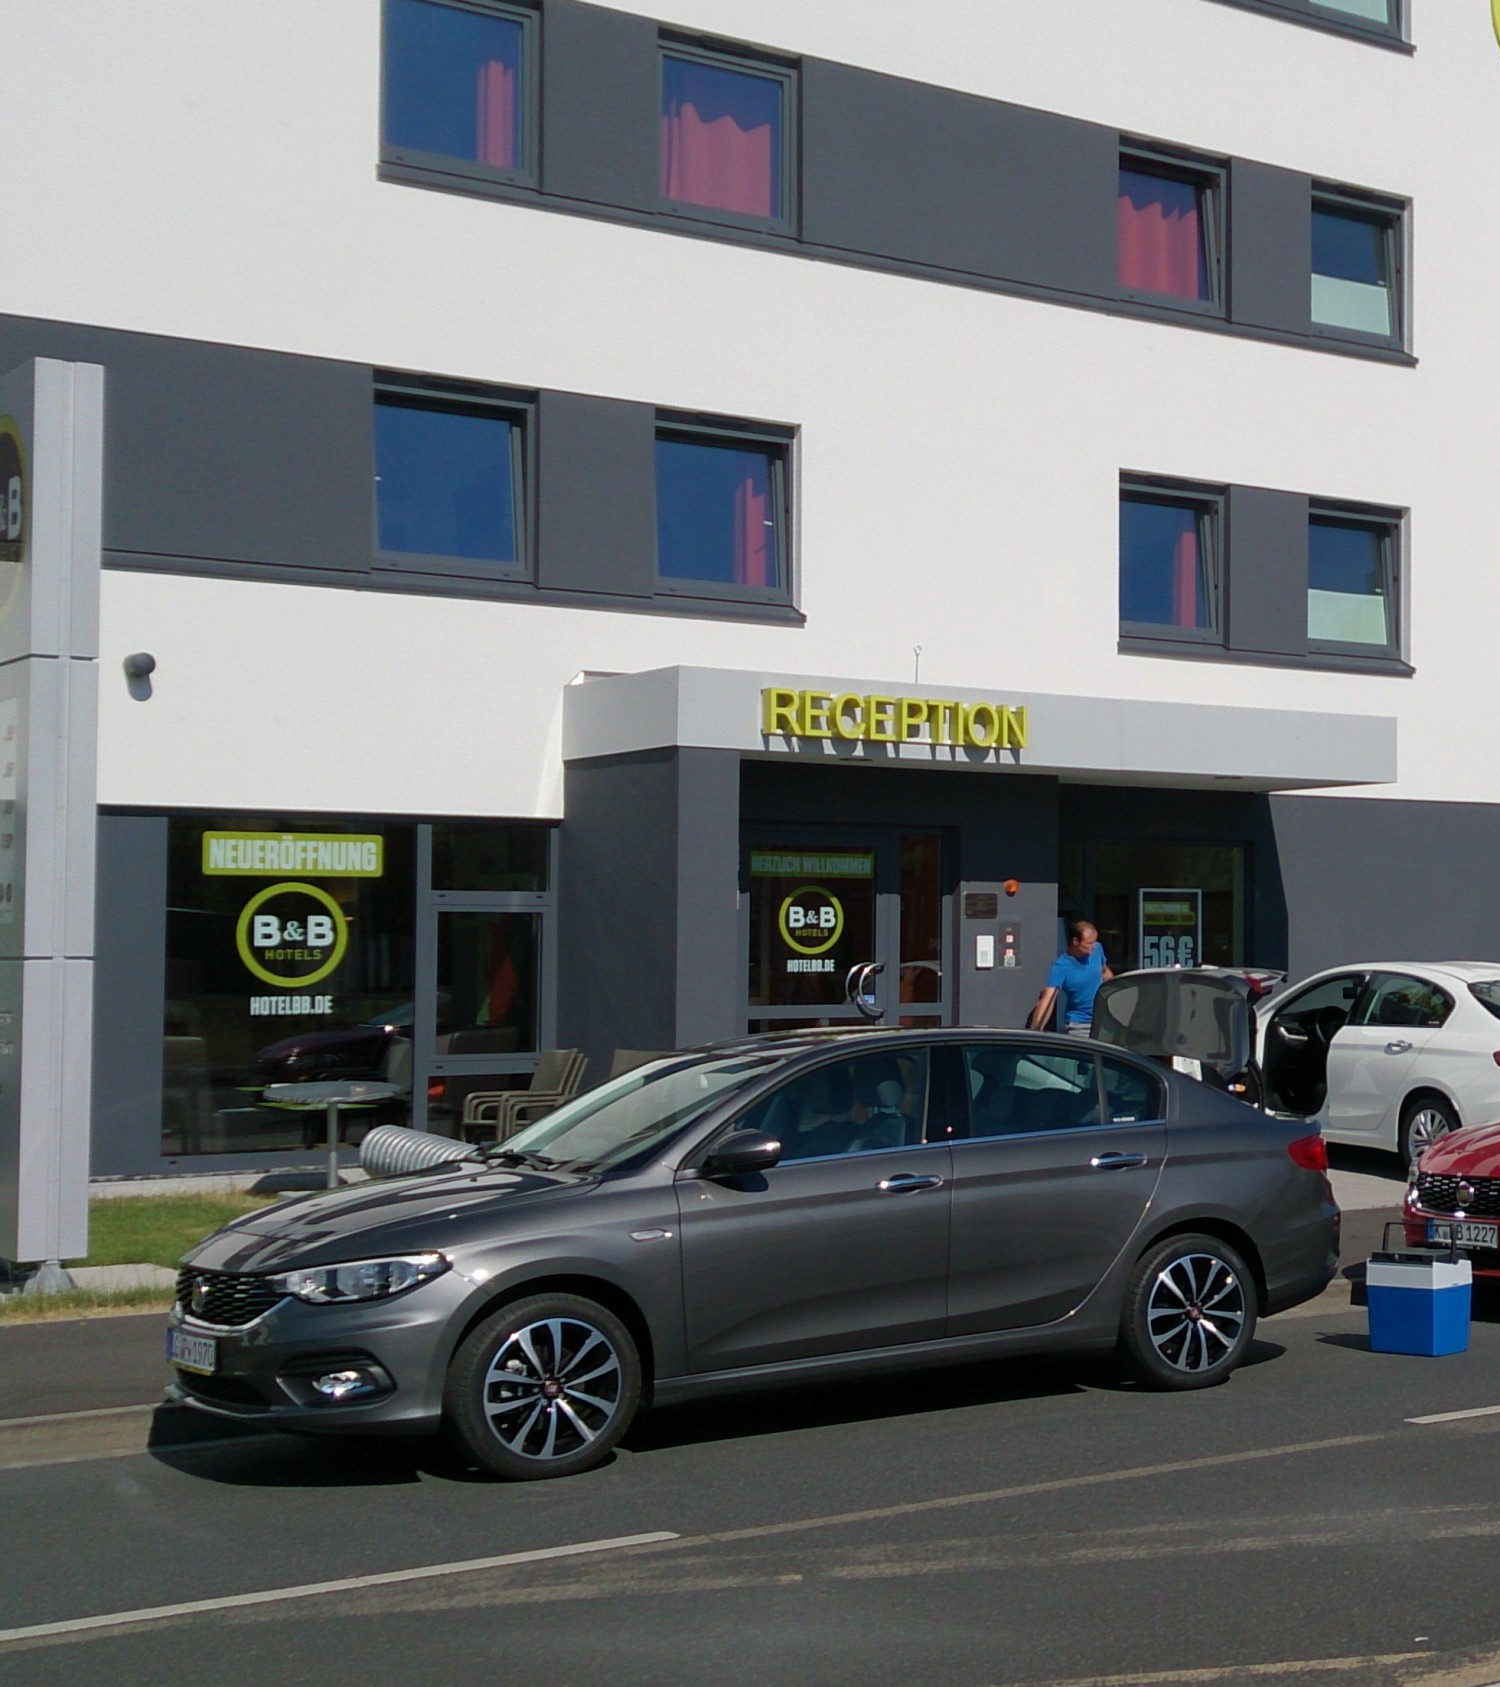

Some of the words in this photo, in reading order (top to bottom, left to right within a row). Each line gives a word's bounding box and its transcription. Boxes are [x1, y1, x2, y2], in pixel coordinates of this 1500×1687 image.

[760, 687, 1029, 749] RECEPTION
[209, 835, 377, 871] NEUERÖFFNUNG
[253, 914, 334, 947] B&B
[788, 906, 836, 928] B&B
[265, 949, 321, 960] HOTELS
[250, 996, 332, 1015] HOTELBB.DE
